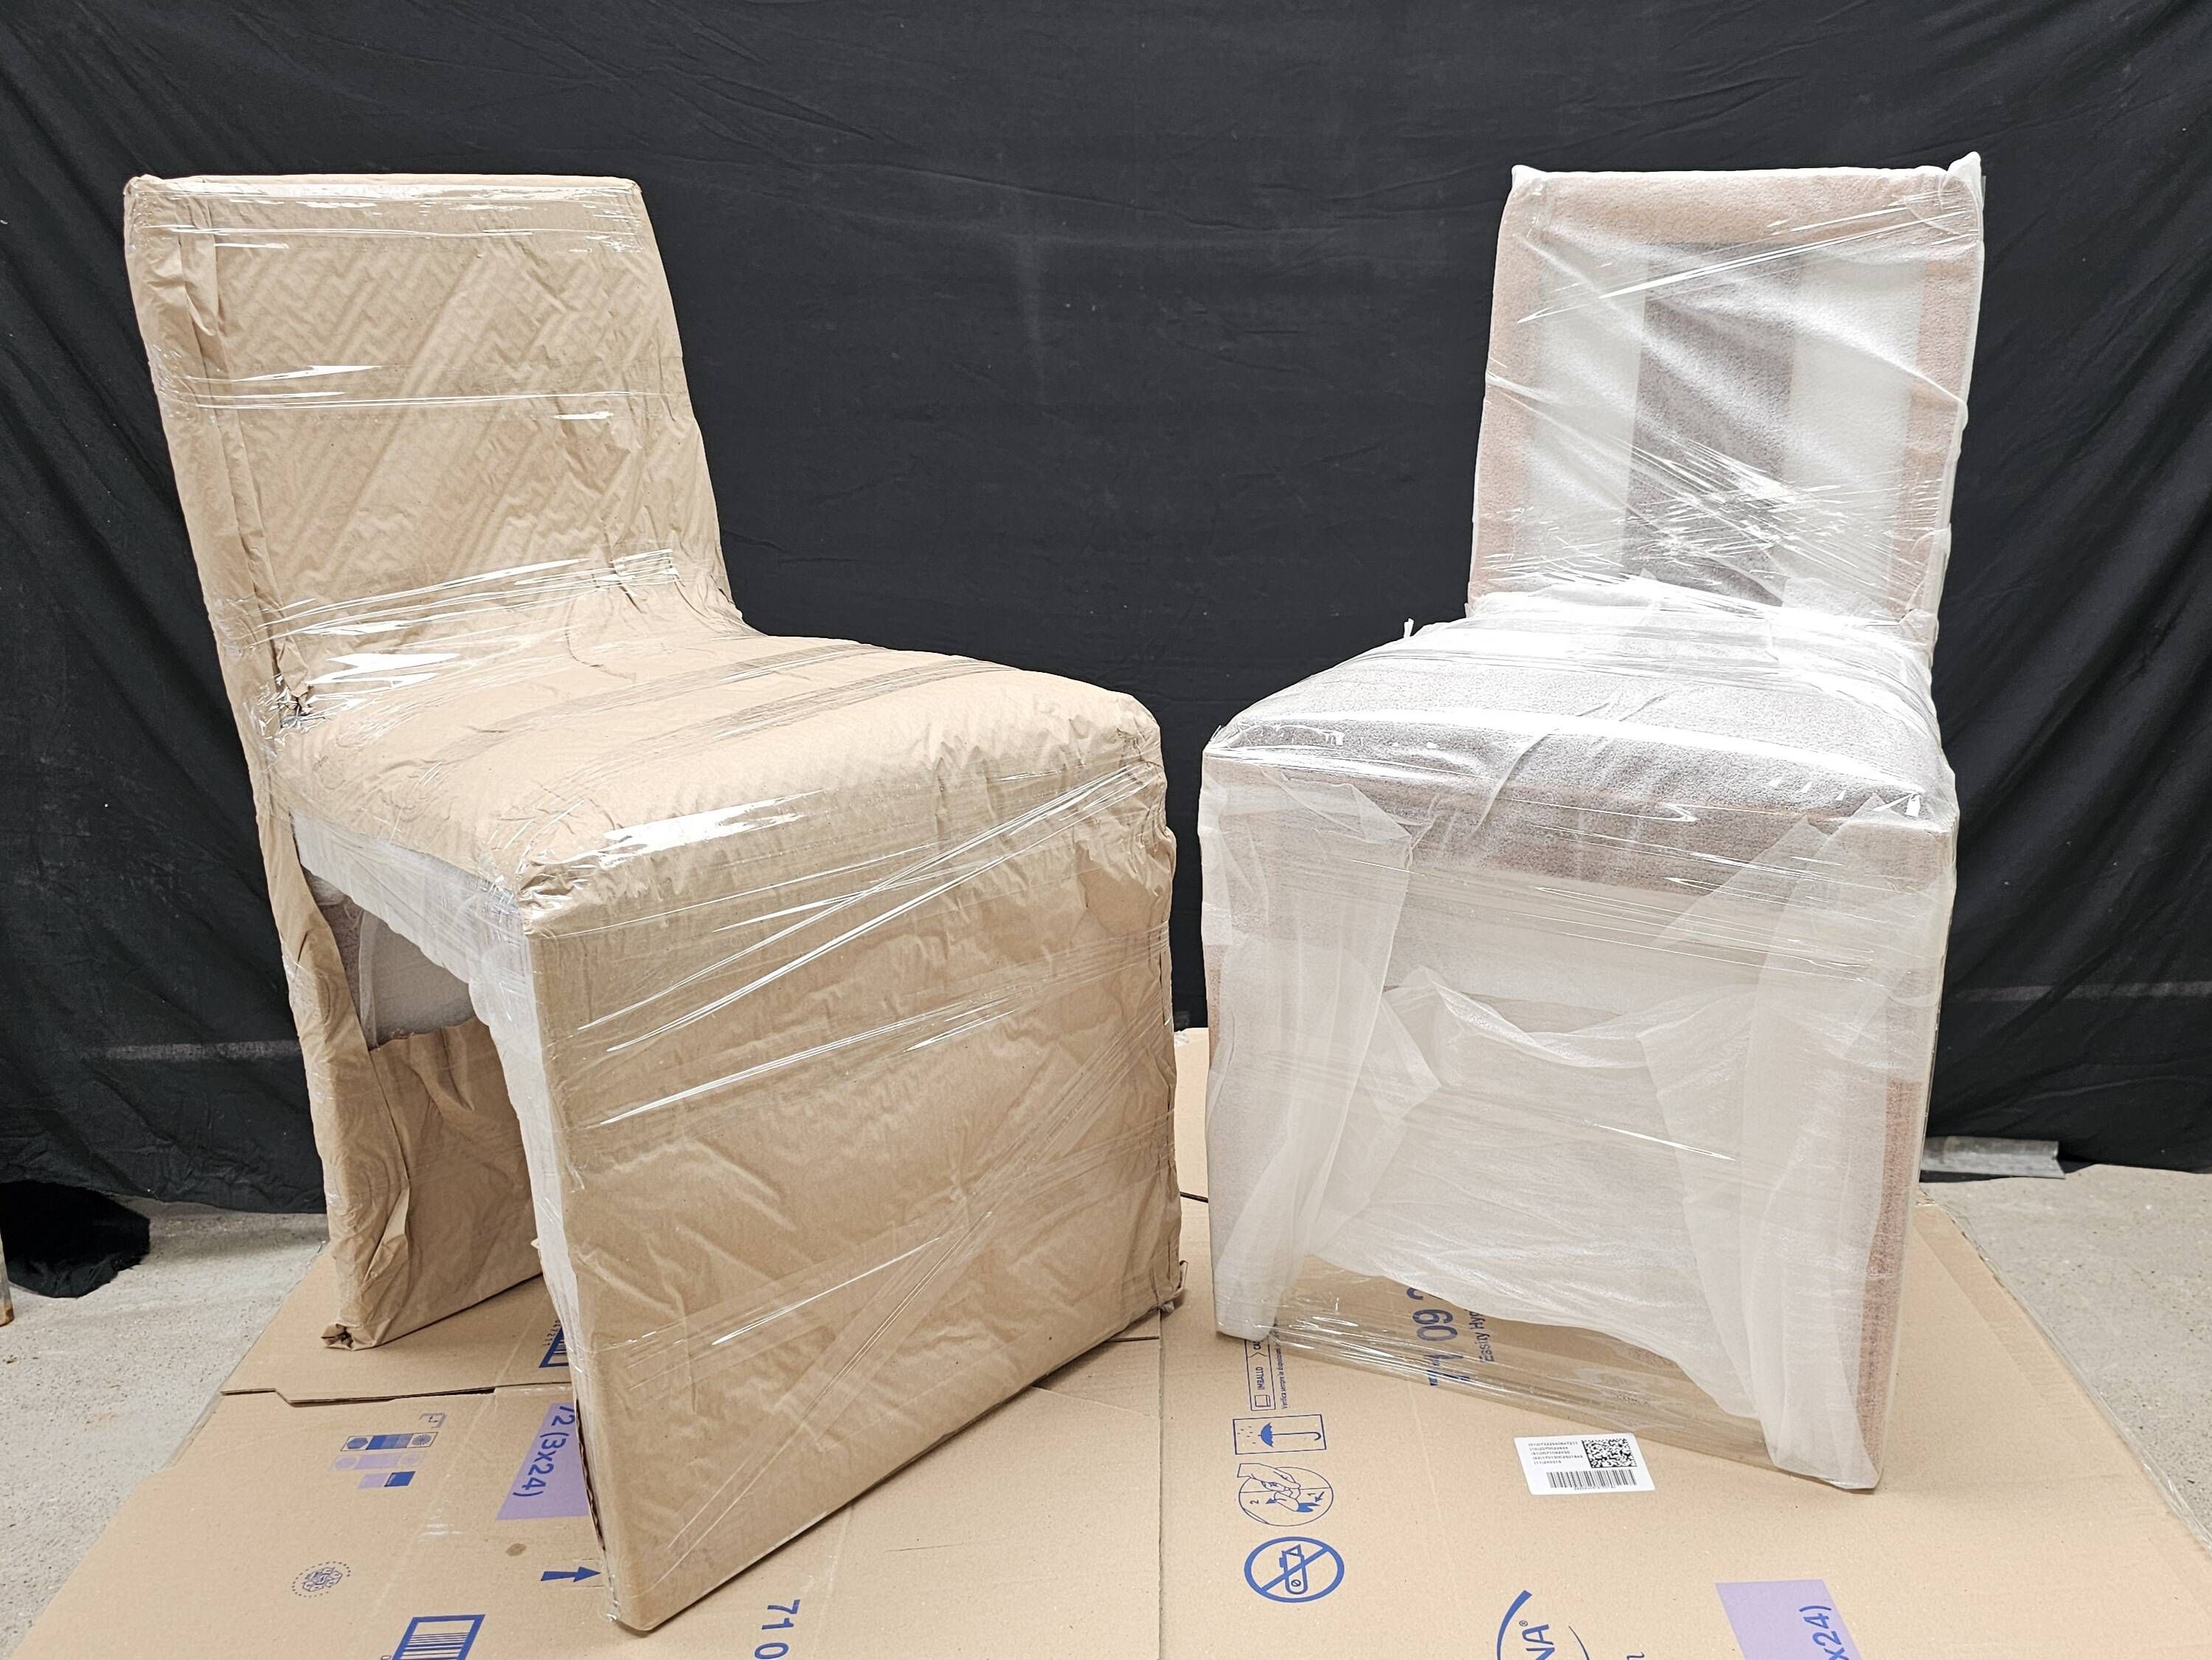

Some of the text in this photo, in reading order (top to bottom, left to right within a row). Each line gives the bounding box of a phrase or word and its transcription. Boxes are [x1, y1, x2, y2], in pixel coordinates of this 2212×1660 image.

[1412, 1309, 1458, 1341] 09
[1255, 1366, 1265, 1390] IMBALLO
[513, 1432, 570, 1497] (3x24)
[761, 1599, 800, 1630] 71
